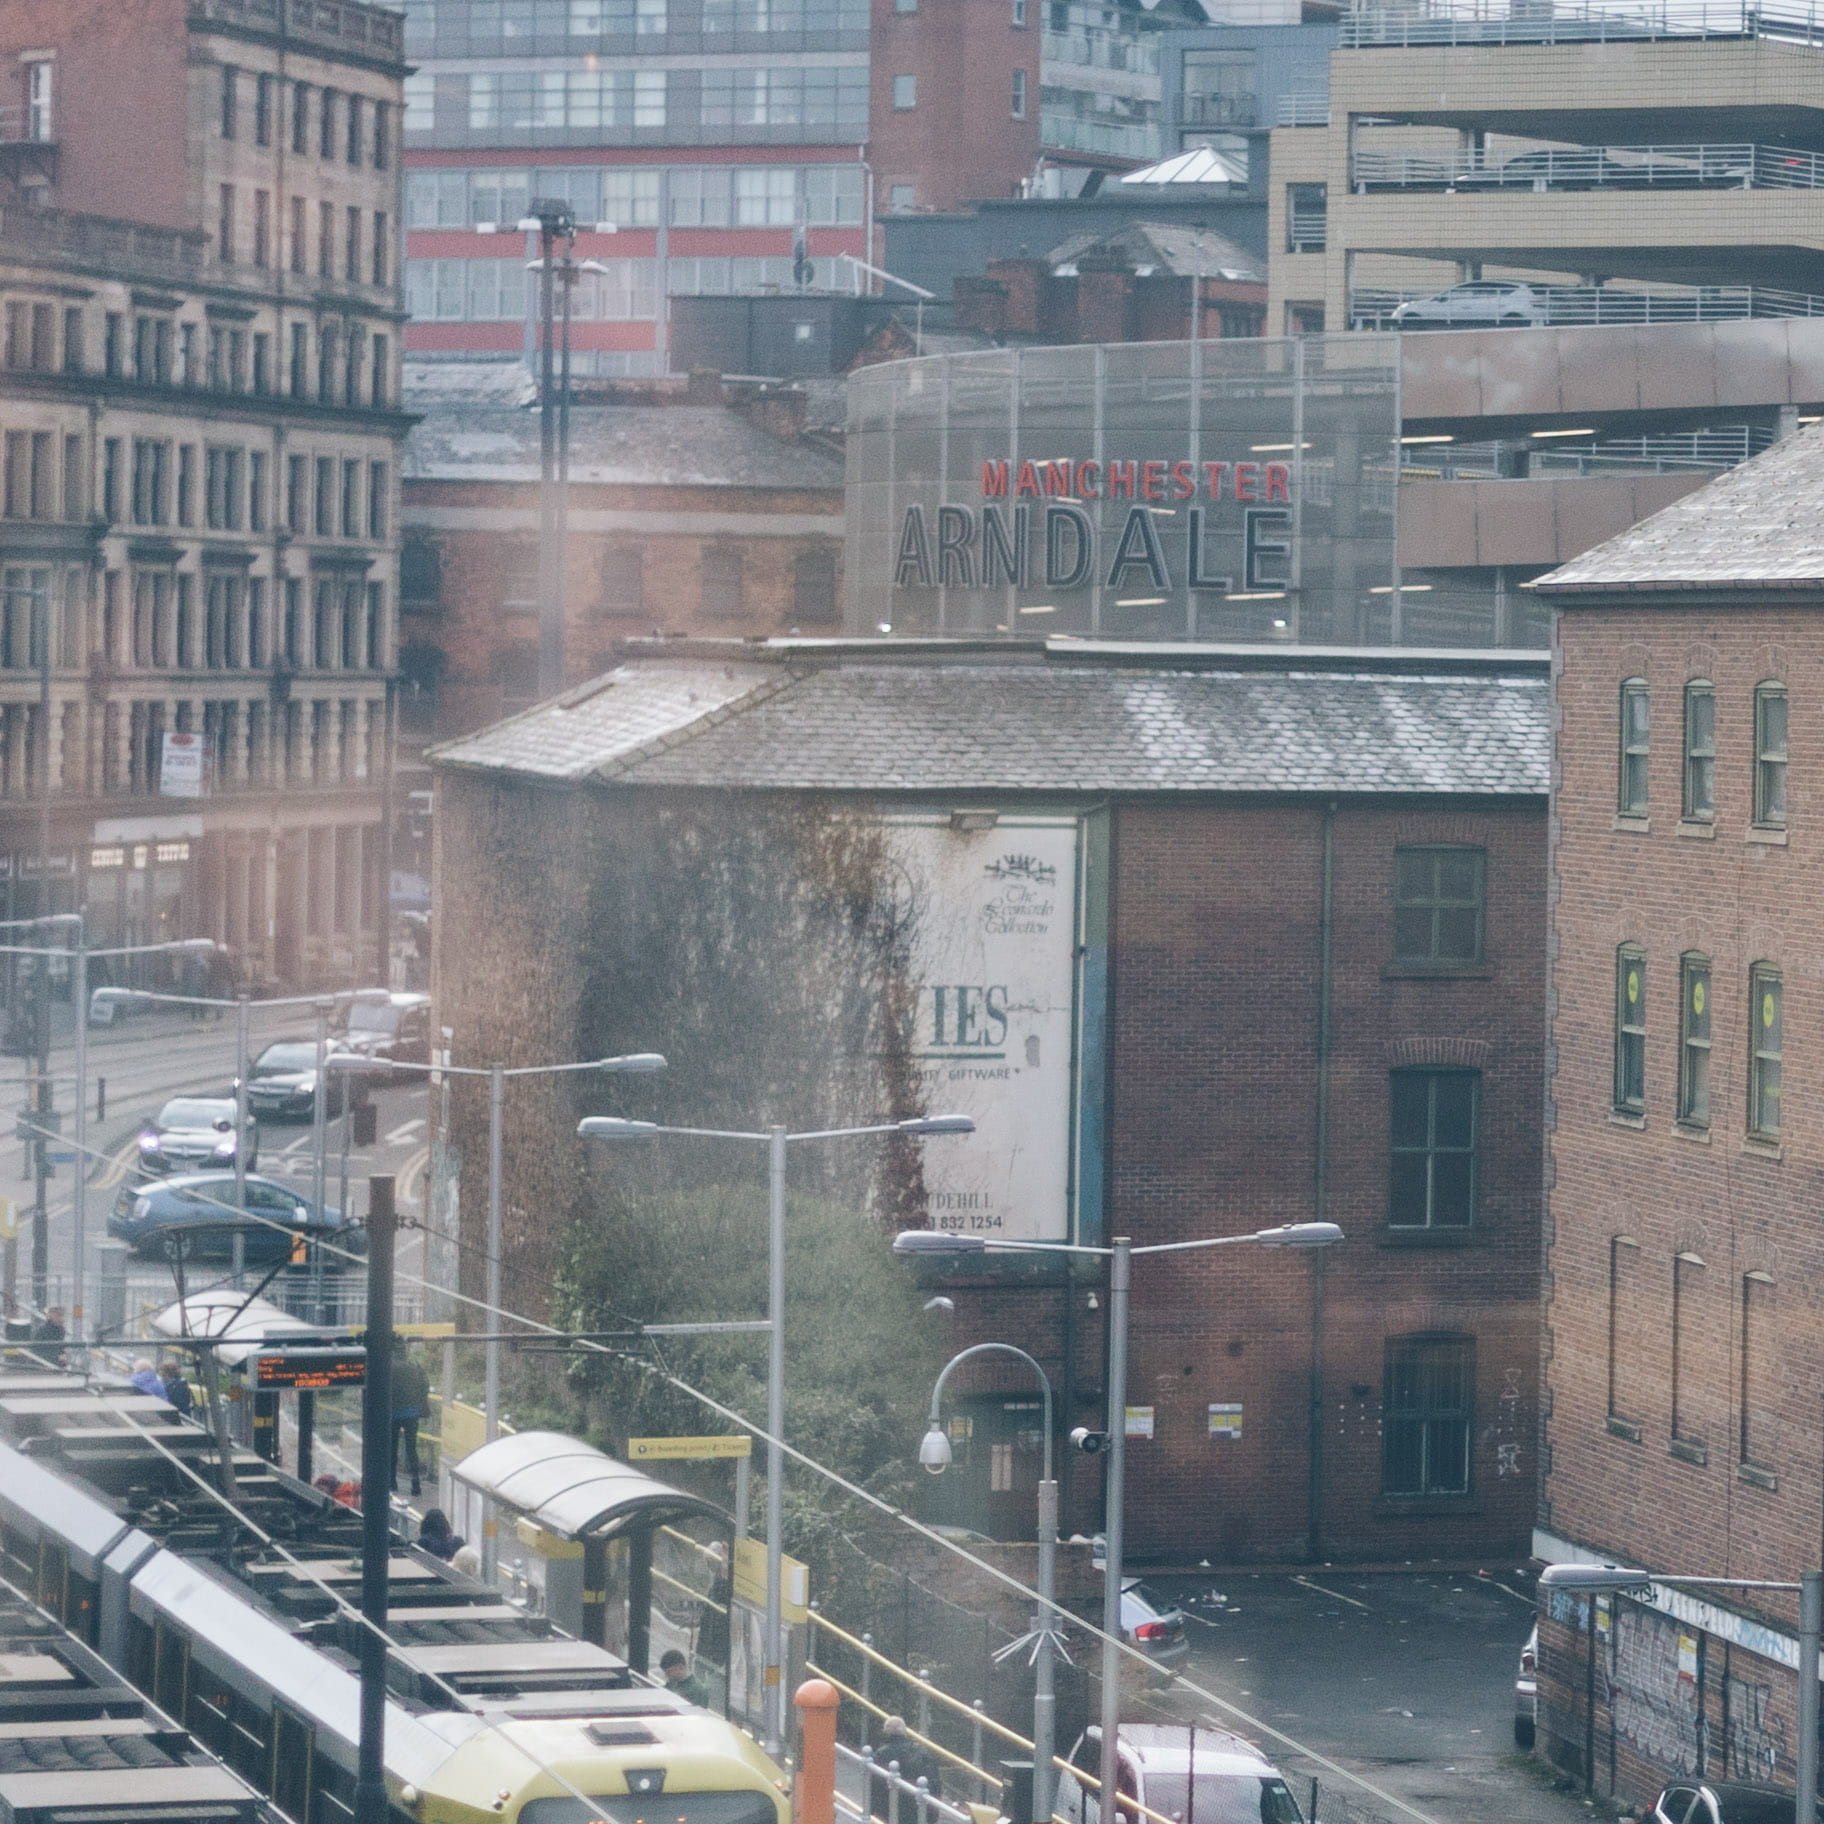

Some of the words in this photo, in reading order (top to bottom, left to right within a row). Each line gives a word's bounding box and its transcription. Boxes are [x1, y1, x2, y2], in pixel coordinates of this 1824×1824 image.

[980, 458, 1292, 501] MANCHESTER
[894, 503, 1294, 593] ARNDALE
[940, 1216, 965, 1230] 832
[970, 1216, 1004, 1230] 1254
